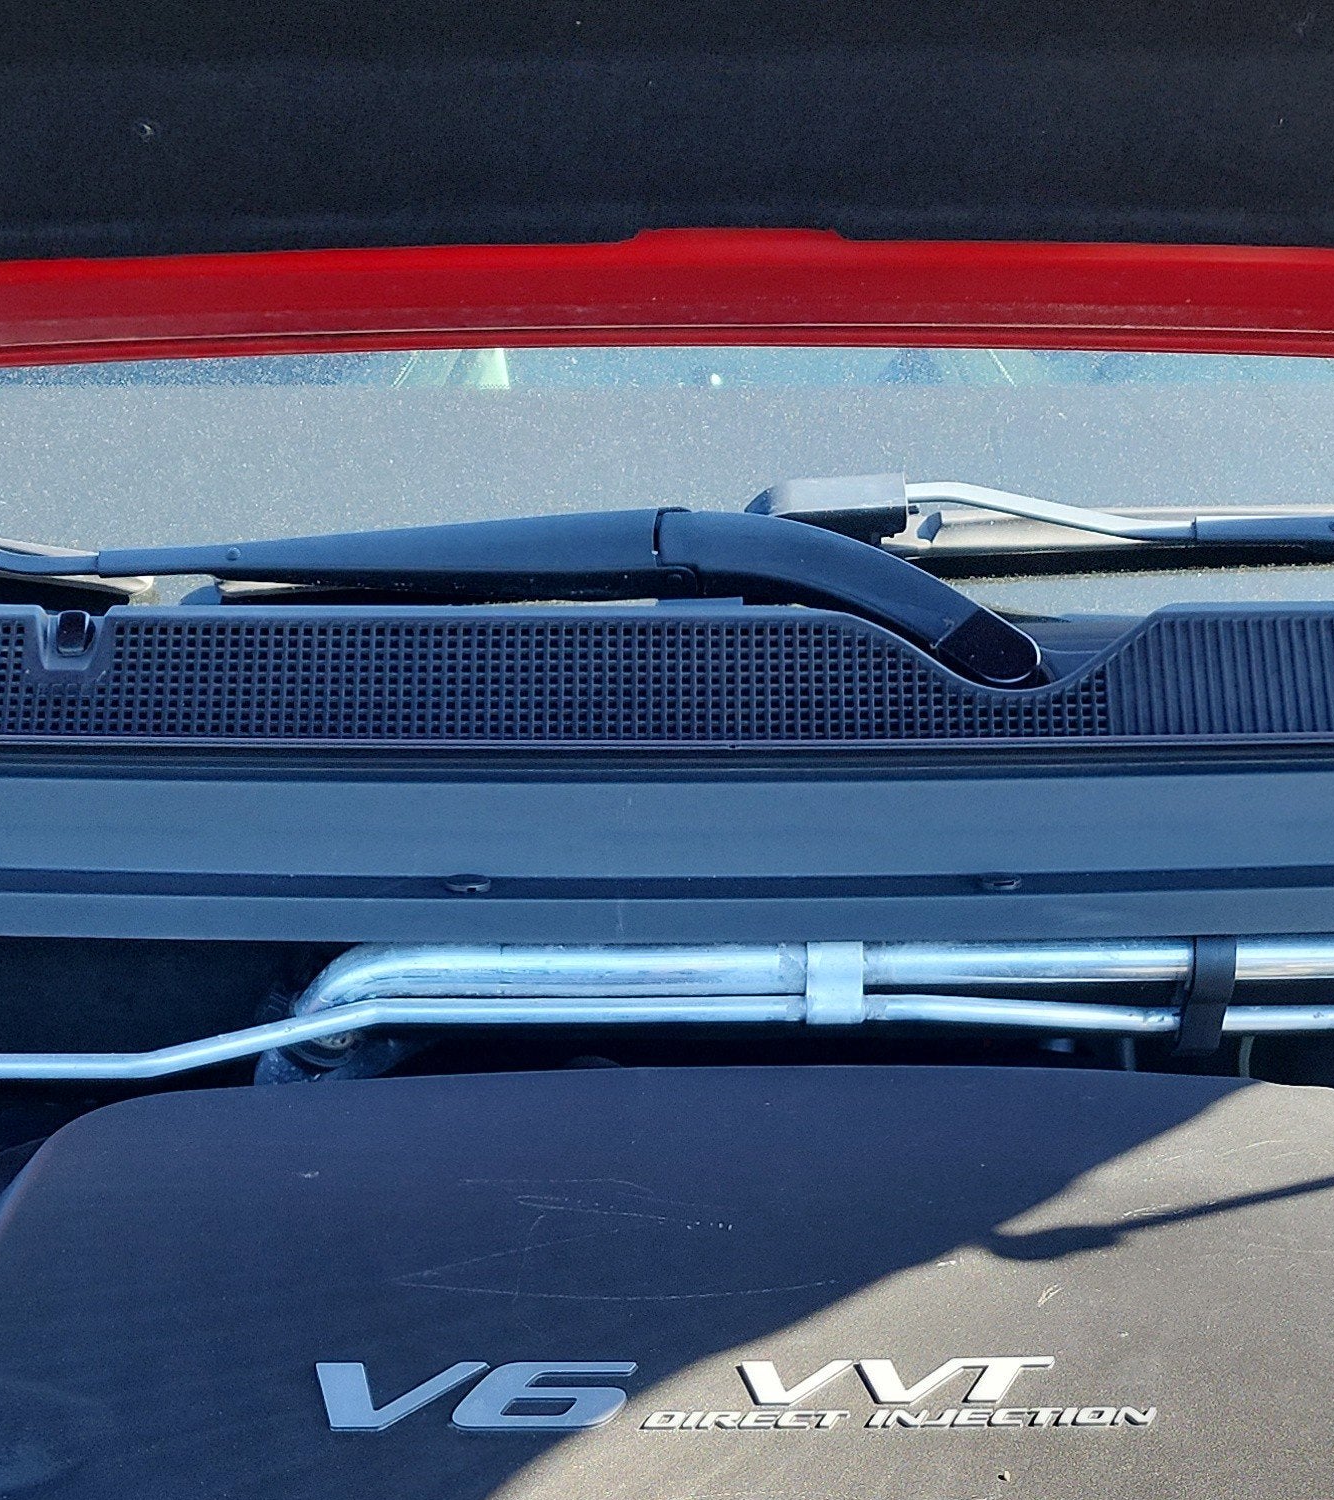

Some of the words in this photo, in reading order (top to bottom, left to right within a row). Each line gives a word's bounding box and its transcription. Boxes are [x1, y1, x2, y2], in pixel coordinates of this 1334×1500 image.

[315, 1361, 639, 1433] V6
[636, 1355, 1055, 1406] VVT
[640, 1408, 850, 1431] DIRECT
[863, 1405, 1158, 1431] INJECTION
